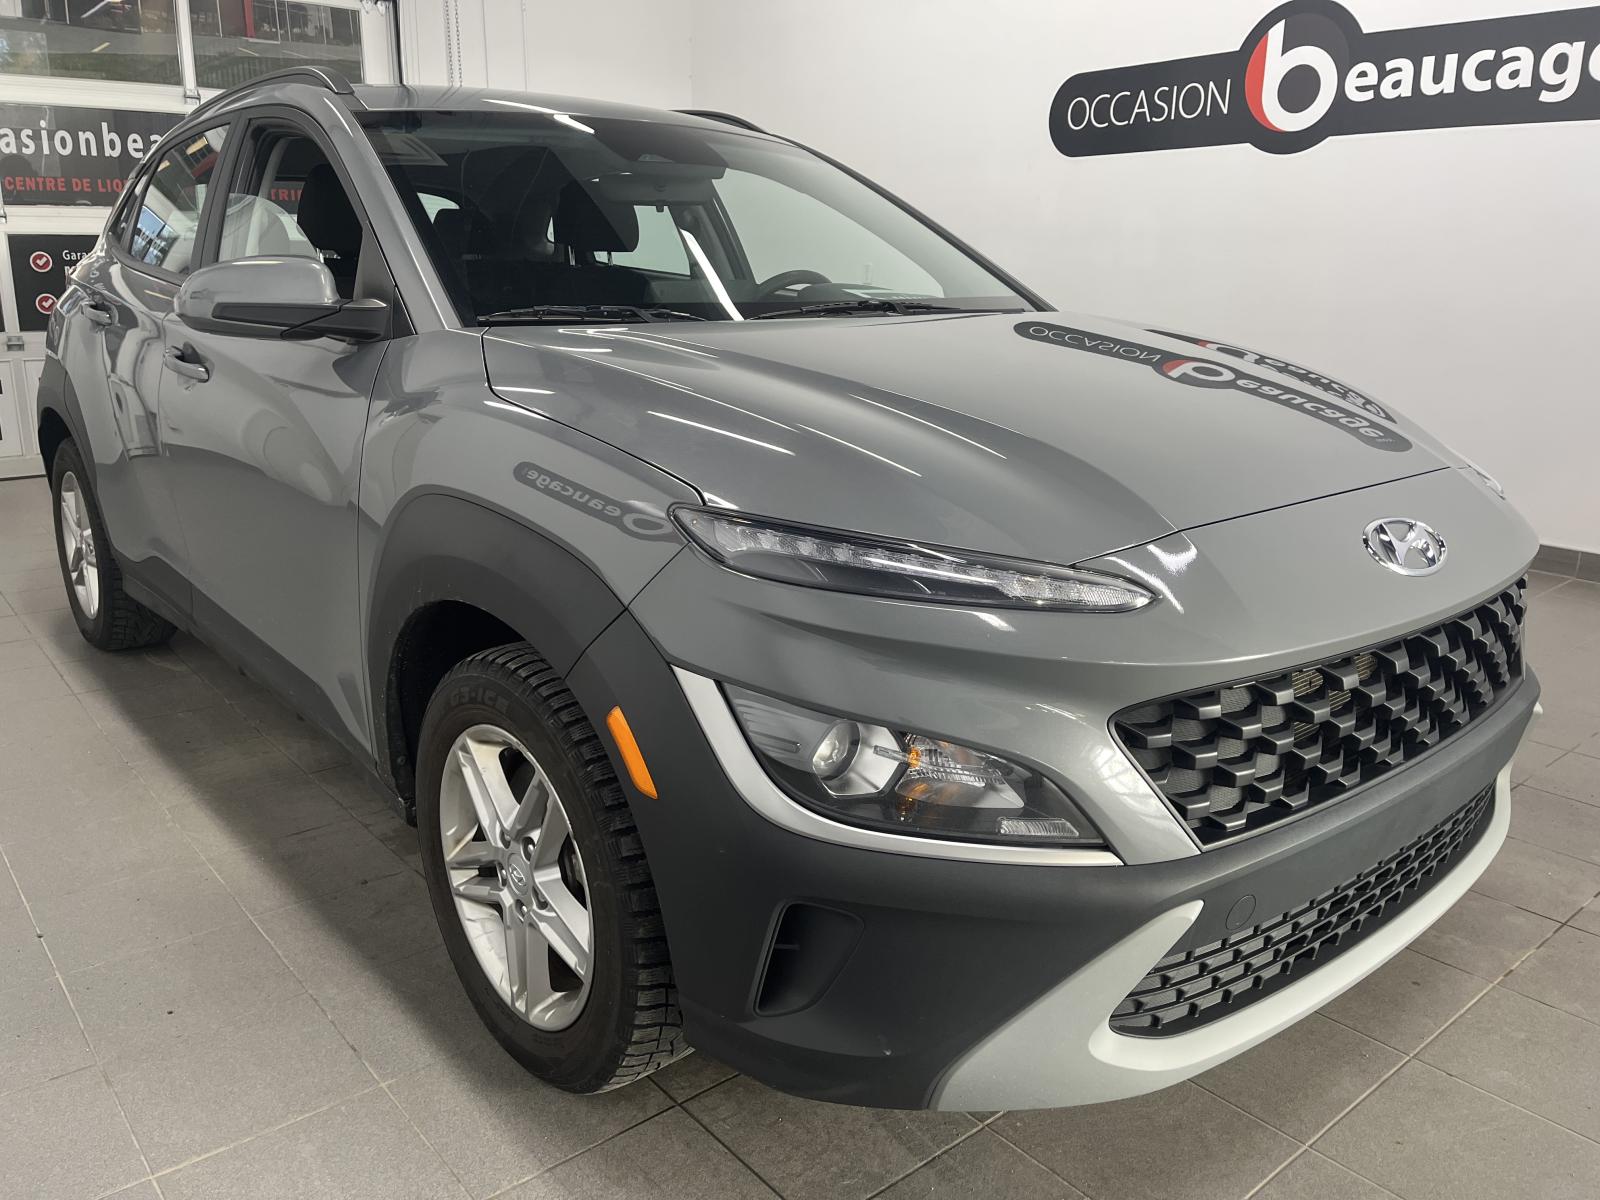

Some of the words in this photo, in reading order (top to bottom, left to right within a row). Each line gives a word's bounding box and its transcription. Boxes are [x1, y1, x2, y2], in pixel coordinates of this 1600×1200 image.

[1068, 79, 1231, 131] OCCASION
[4, 176, 66, 192] CENTRE
[72, 179, 92, 192] DE
